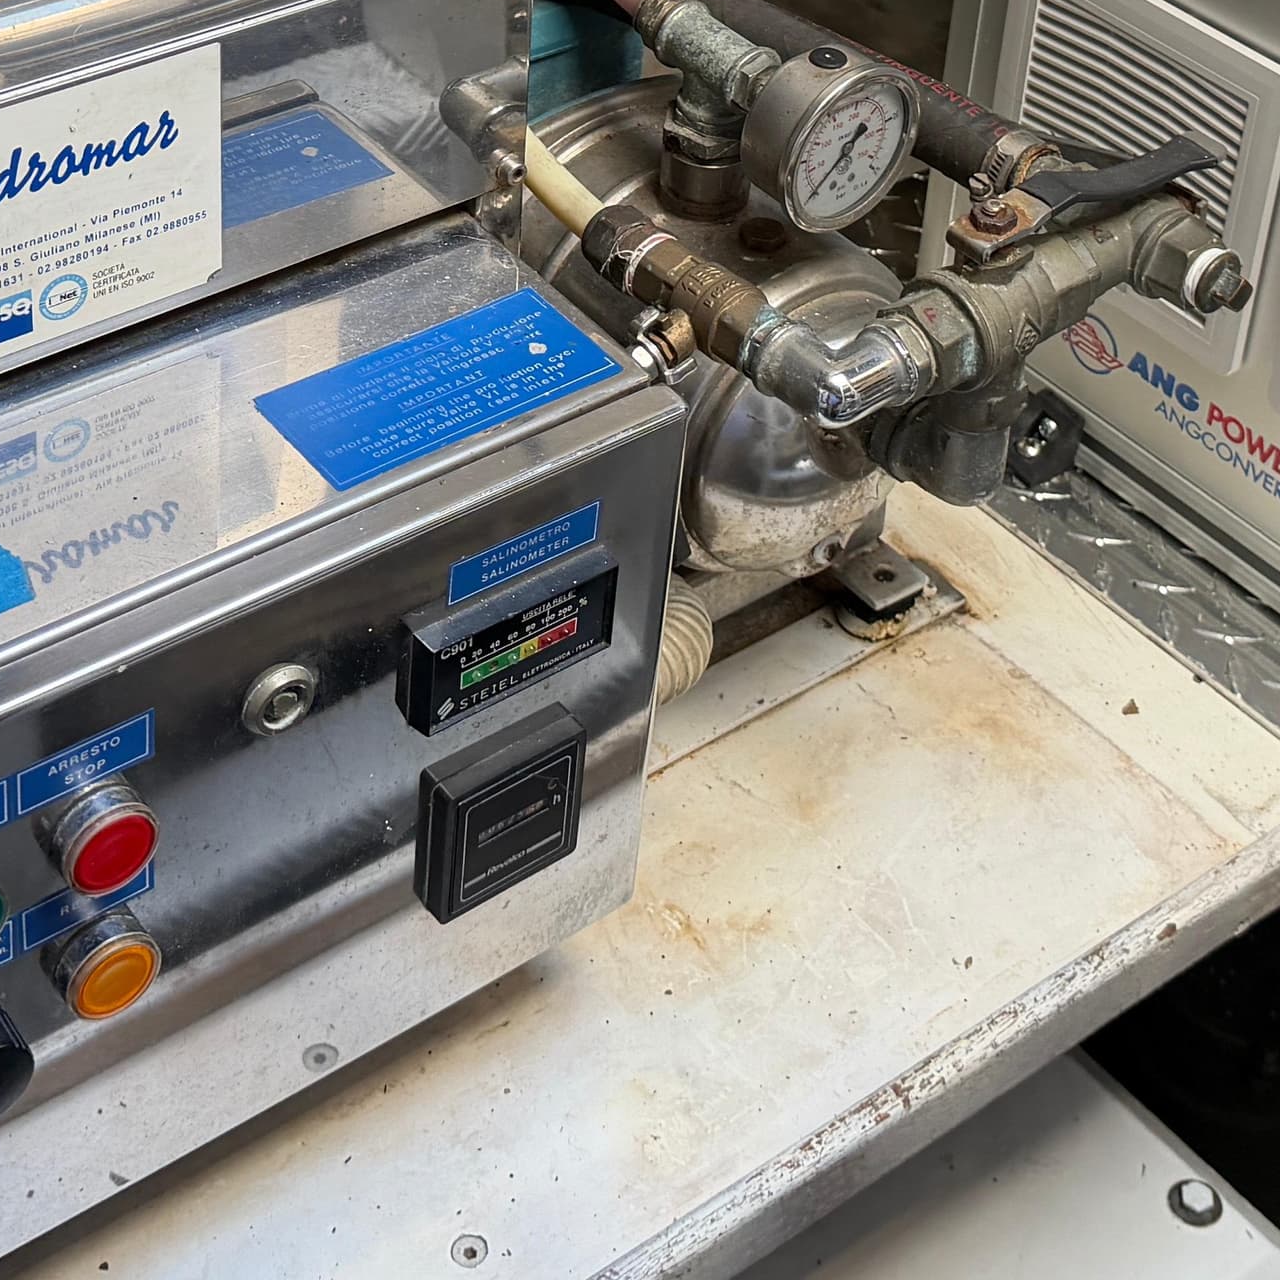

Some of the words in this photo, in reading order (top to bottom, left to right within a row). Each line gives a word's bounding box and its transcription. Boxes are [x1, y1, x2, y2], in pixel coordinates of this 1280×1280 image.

[0, 223, 78, 256] International
[90, 213, 109, 226] Via
[112, 195, 166, 219] Piemonte
[170, 188, 183, 199] 14
[13, 257, 25, 269] S.
[30, 239, 80, 263] Giuliano
[84, 221, 136, 244] Milanese
[139, 211, 161, 227] (MI)
[37, 244, 110, 276] 02.98280194
[122, 234, 142, 247] Fax
[146, 210, 208, 239] 02.9880955
[92, 267, 140, 290] CERTIFICATA
[93, 290, 107, 299] UNI
[108, 286, 119, 294] EN
[121, 279, 134, 290] ISO
[136, 271, 155, 285] 9002
[398, 370, 484, 410] IMPORTANT
[1128, 352, 1200, 412] ANG
[360, 434, 398, 454] make
[405, 418, 435, 434] sure
[440, 400, 478, 418] Valve
[542, 361, 566, 376] the
[377, 404, 446, 435] beginning
[448, 392, 470, 407] the
[372, 435, 424, 458] correct
[429, 408, 483, 435] position
[480, 535, 570, 584] SALINOMETER
[481, 521, 571, 568] SALINOMETRO
[440, 638, 473, 660] C901
[471, 649, 483, 658] 20
[490, 640, 501, 649] 40
[507, 631, 518, 640] 60
[525, 623, 536, 632] 80
[557, 605, 573, 617] 200
[459, 675, 519, 710] STEIEL
[522, 652, 570, 679] ELETTRONICA
[575, 639, 595, 651] ITALY
[47, 735, 121, 777] ARRESTO
[64, 758, 107, 786] STOP
